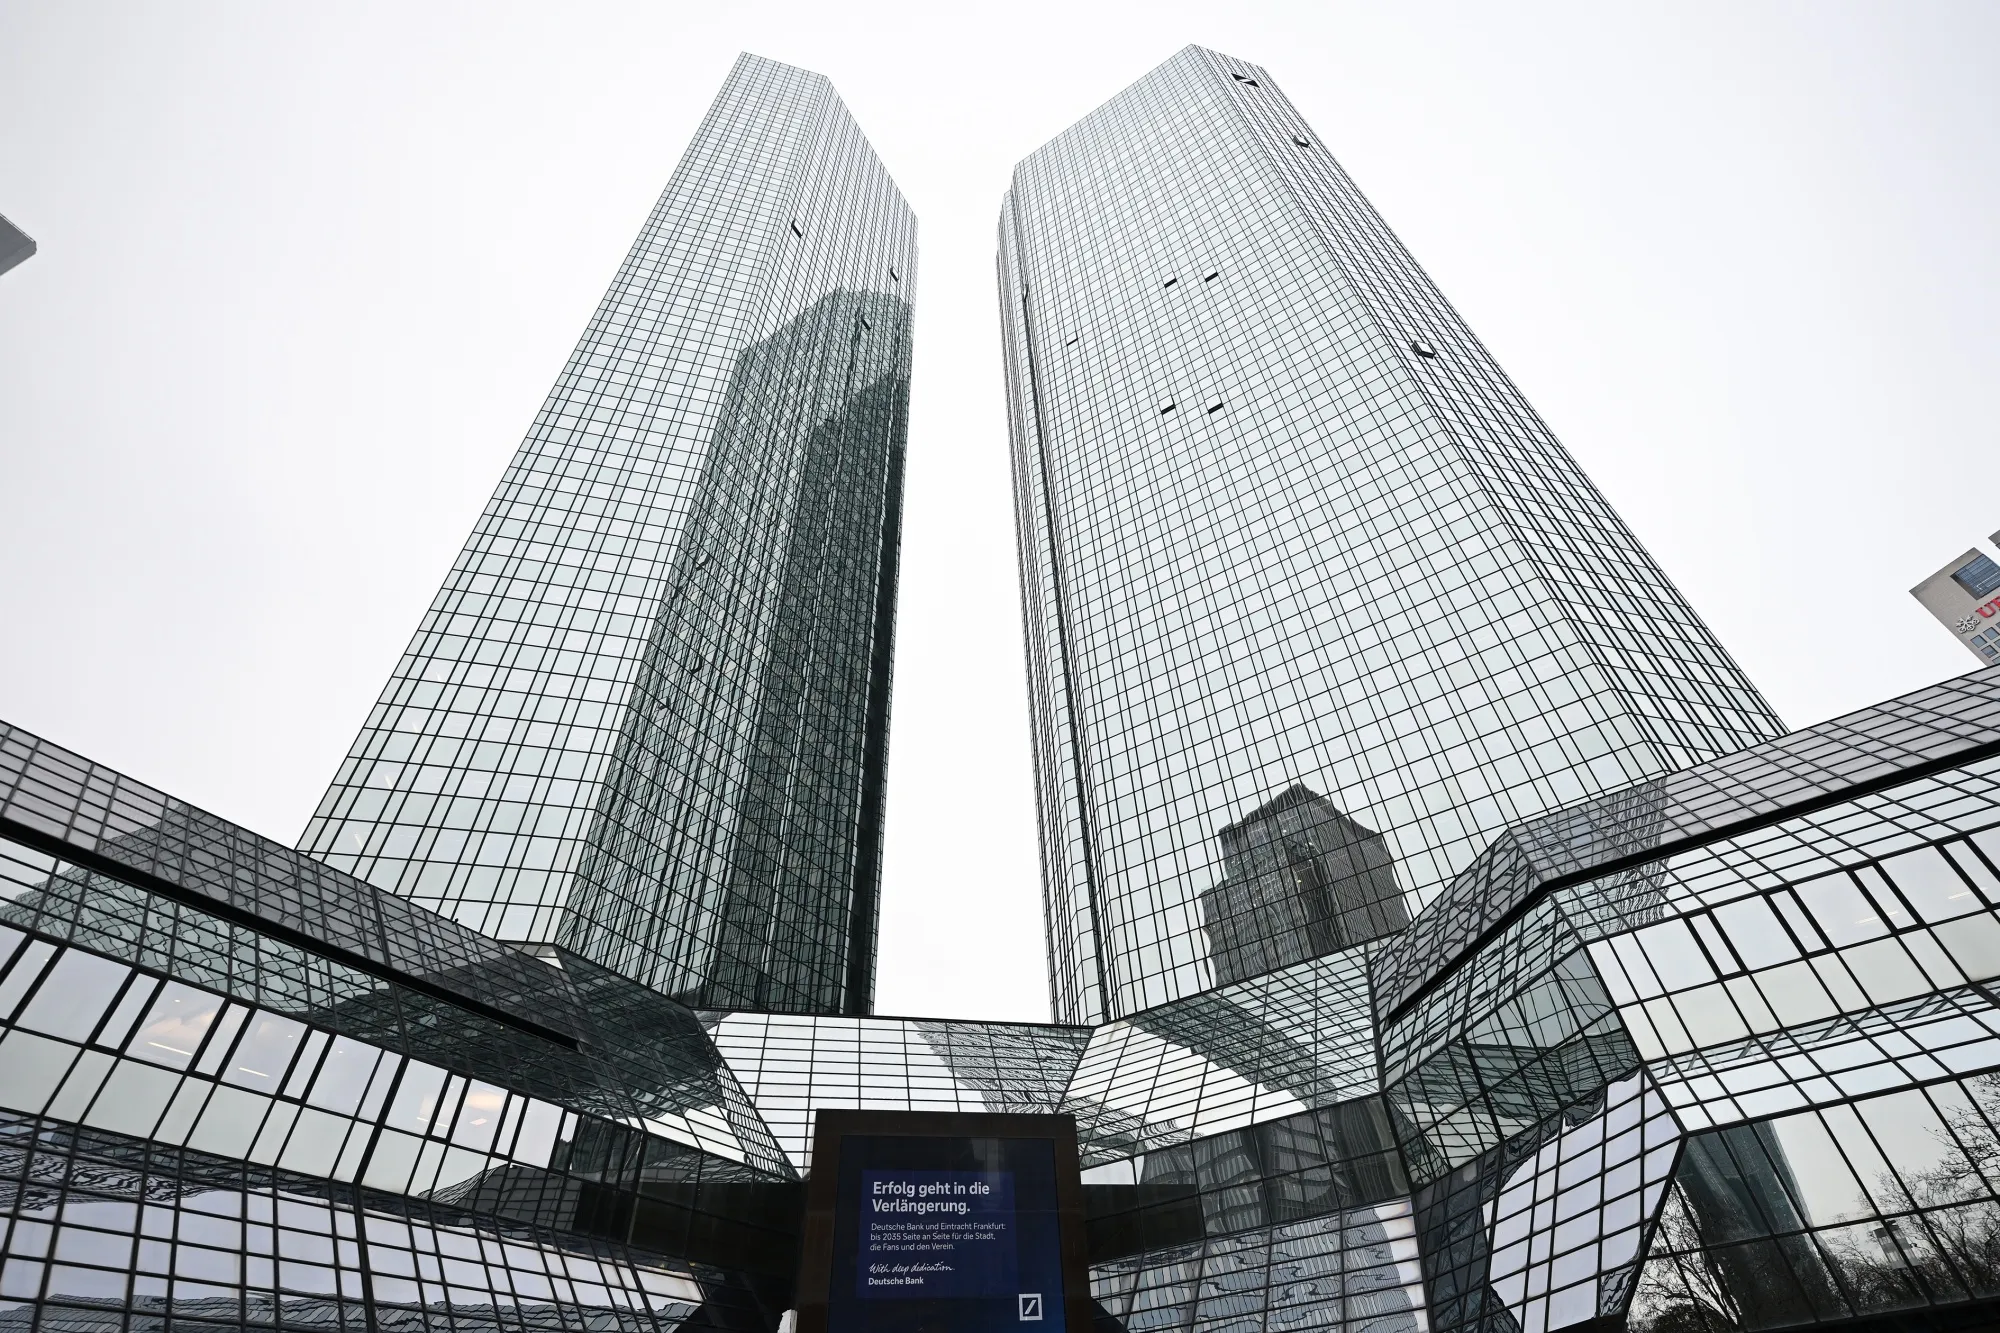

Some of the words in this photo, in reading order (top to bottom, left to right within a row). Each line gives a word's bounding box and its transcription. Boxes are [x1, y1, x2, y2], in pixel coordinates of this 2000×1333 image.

[873, 1181, 916, 1197] Erfolg
[919, 1181, 951, 1197] geht
[954, 1182, 966, 1195] in
[969, 1182, 990, 1195] die
[872, 1198, 971, 1215] Verlängerung.
[871, 1222, 905, 1231] Deutsche
[906, 1222, 924, 1231] Bank
[925, 1223, 939, 1231] und
[940, 1222, 972, 1230] Eintracht
[870, 1233, 881, 1241] bis
[882, 1233, 901, 1241] 2035
[902, 1232, 921, 1241] Seite
[932, 1232, 950, 1240] Seite
[951, 1232, 962, 1240] für
[963, 1232, 974, 1240] die
[975, 1232, 996, 1241] Stadt,
[869, 1243, 881, 1251] die
[882, 1243, 900, 1251] Fans
[901, 1243, 915, 1251] und
[916, 1242, 930, 1250] den
[931, 1242, 955, 1250] Verein.
[869, 1263, 891, 1274] With
[892, 1263, 910, 1276] deep
[868, 1277, 904, 1286] Deutsche
[905, 1276, 924, 1285] Bank
